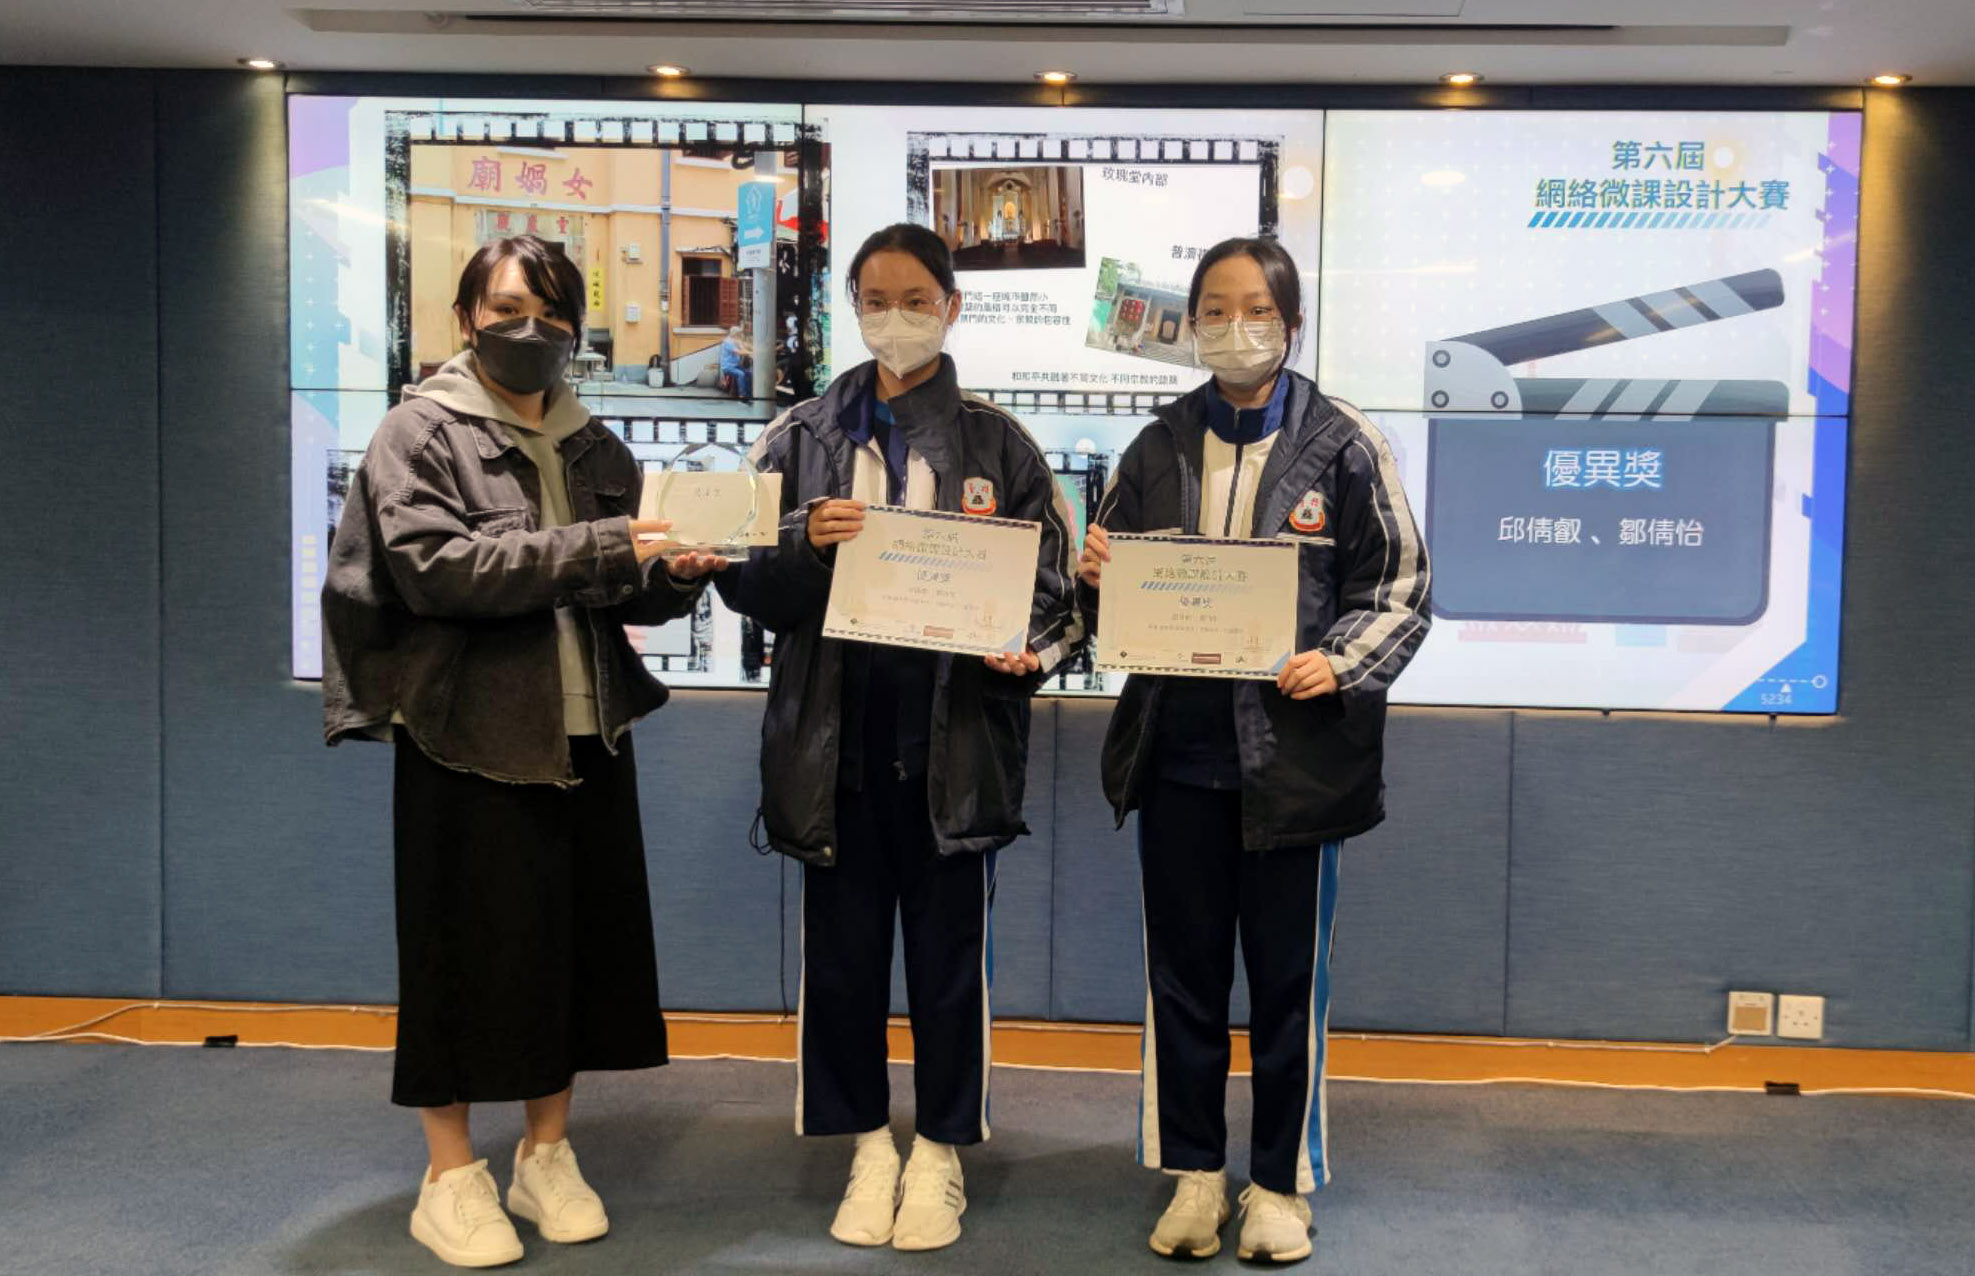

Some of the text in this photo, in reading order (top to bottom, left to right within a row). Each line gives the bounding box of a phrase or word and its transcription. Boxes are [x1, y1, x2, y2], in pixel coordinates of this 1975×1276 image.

[1612, 140, 1704, 171] 第六屆
[1535, 178, 1789, 210] 網絡微課設計大賽
[1544, 450, 1662, 488] 優異獎
